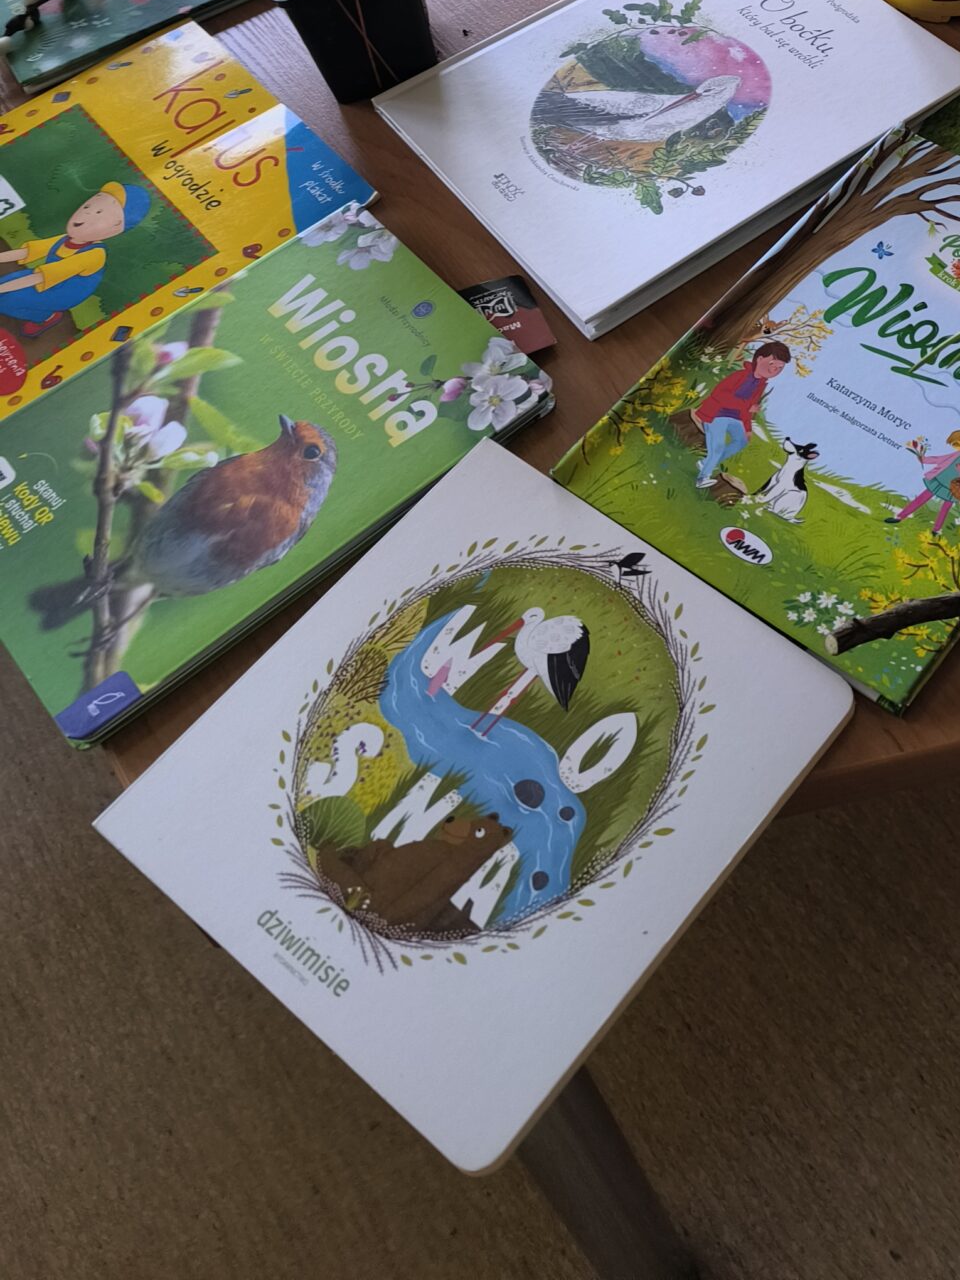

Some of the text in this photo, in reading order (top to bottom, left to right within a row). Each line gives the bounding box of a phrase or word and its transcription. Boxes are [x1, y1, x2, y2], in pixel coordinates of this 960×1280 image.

[163, 159, 223, 212] ogrodzie
[300, 179, 333, 205] plakat
[937, 271, 958, 287] krok
[267, 274, 438, 448] Wiosna
[270, 341, 310, 390] ŚWIECIE
[308, 389, 365, 441] PRZYRODY
[826, 377, 913, 431] Katarzyna Moryc
[839, 410, 878, 437] Małgorzata
[877, 432, 903, 451] Detner
[4, 499, 38, 534] słuchaj
[13, 481, 54, 526] kody QR
[33, 479, 66, 510] skanuj
[257, 910, 350, 997] dziwimisie
